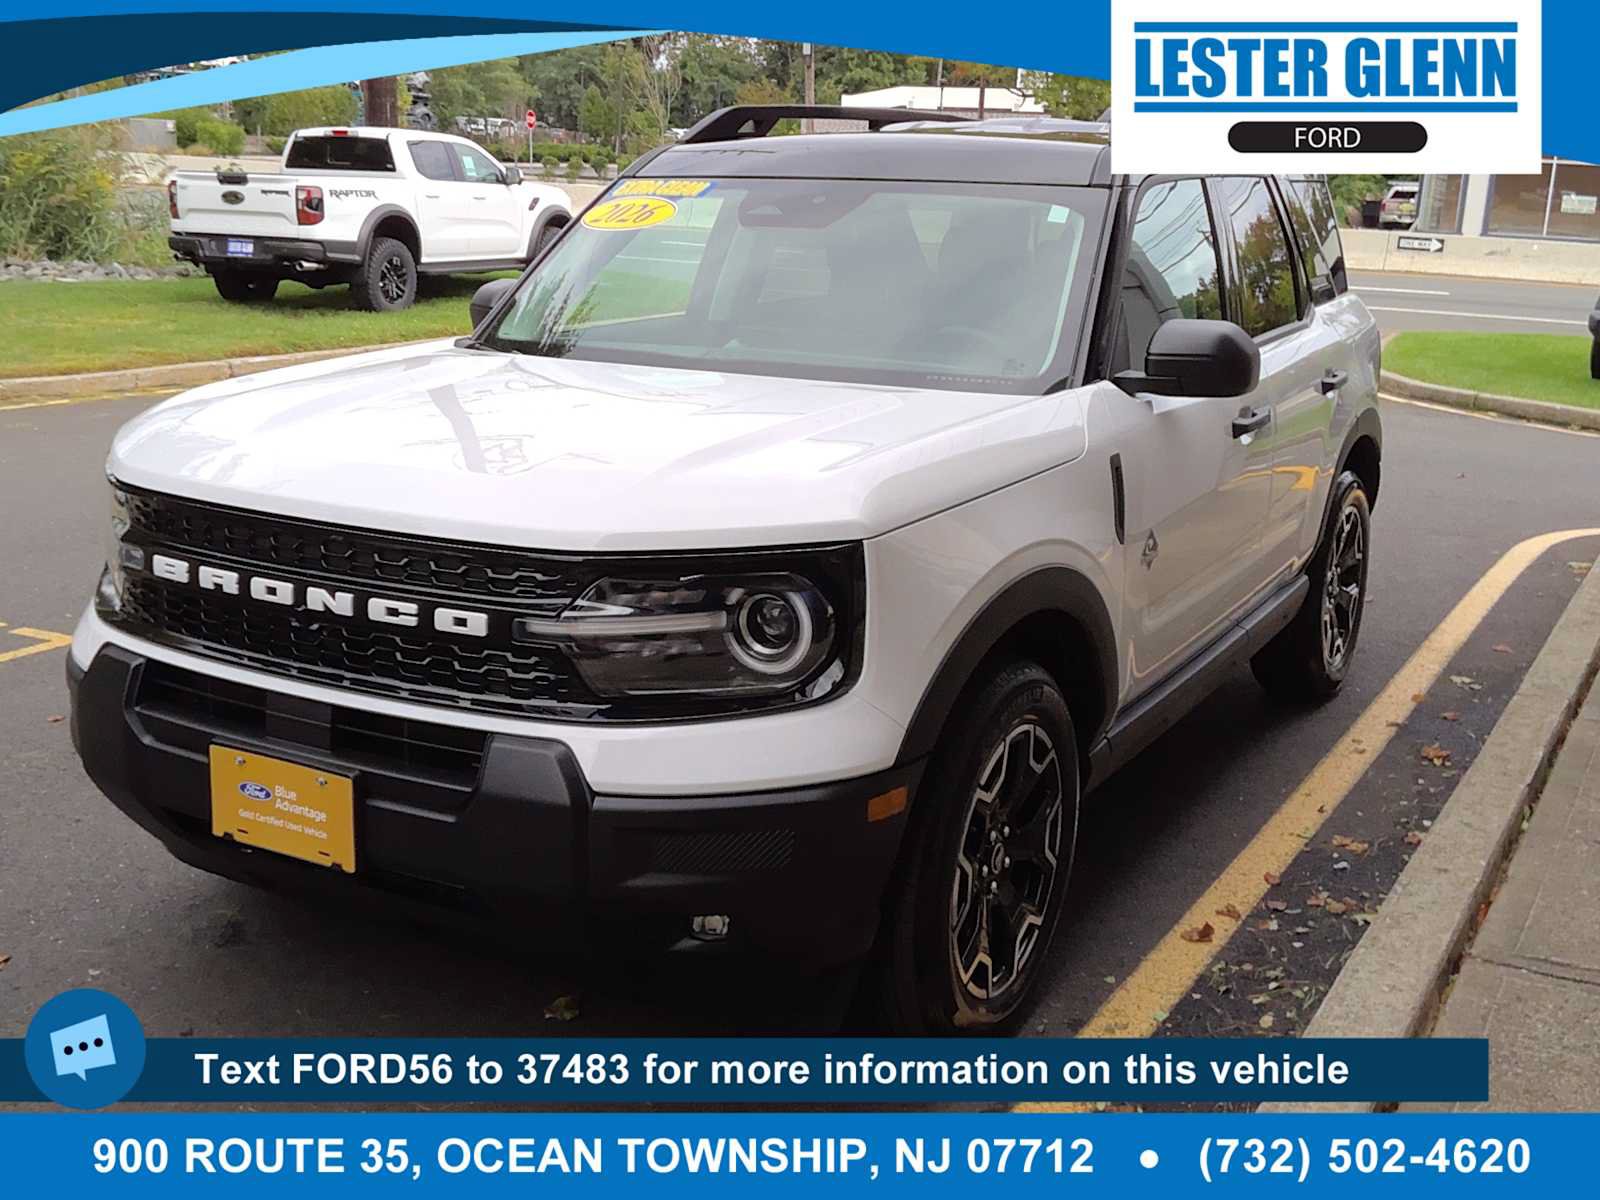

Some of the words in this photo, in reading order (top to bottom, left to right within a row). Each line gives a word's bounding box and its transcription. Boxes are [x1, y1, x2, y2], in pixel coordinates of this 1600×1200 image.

[329, 189, 379, 200] RAPTOR
[588, 203, 663, 223] 2026
[152, 553, 489, 637] BRONCO
[274, 785, 297, 801] Blue
[275, 798, 327, 822] Advantage
